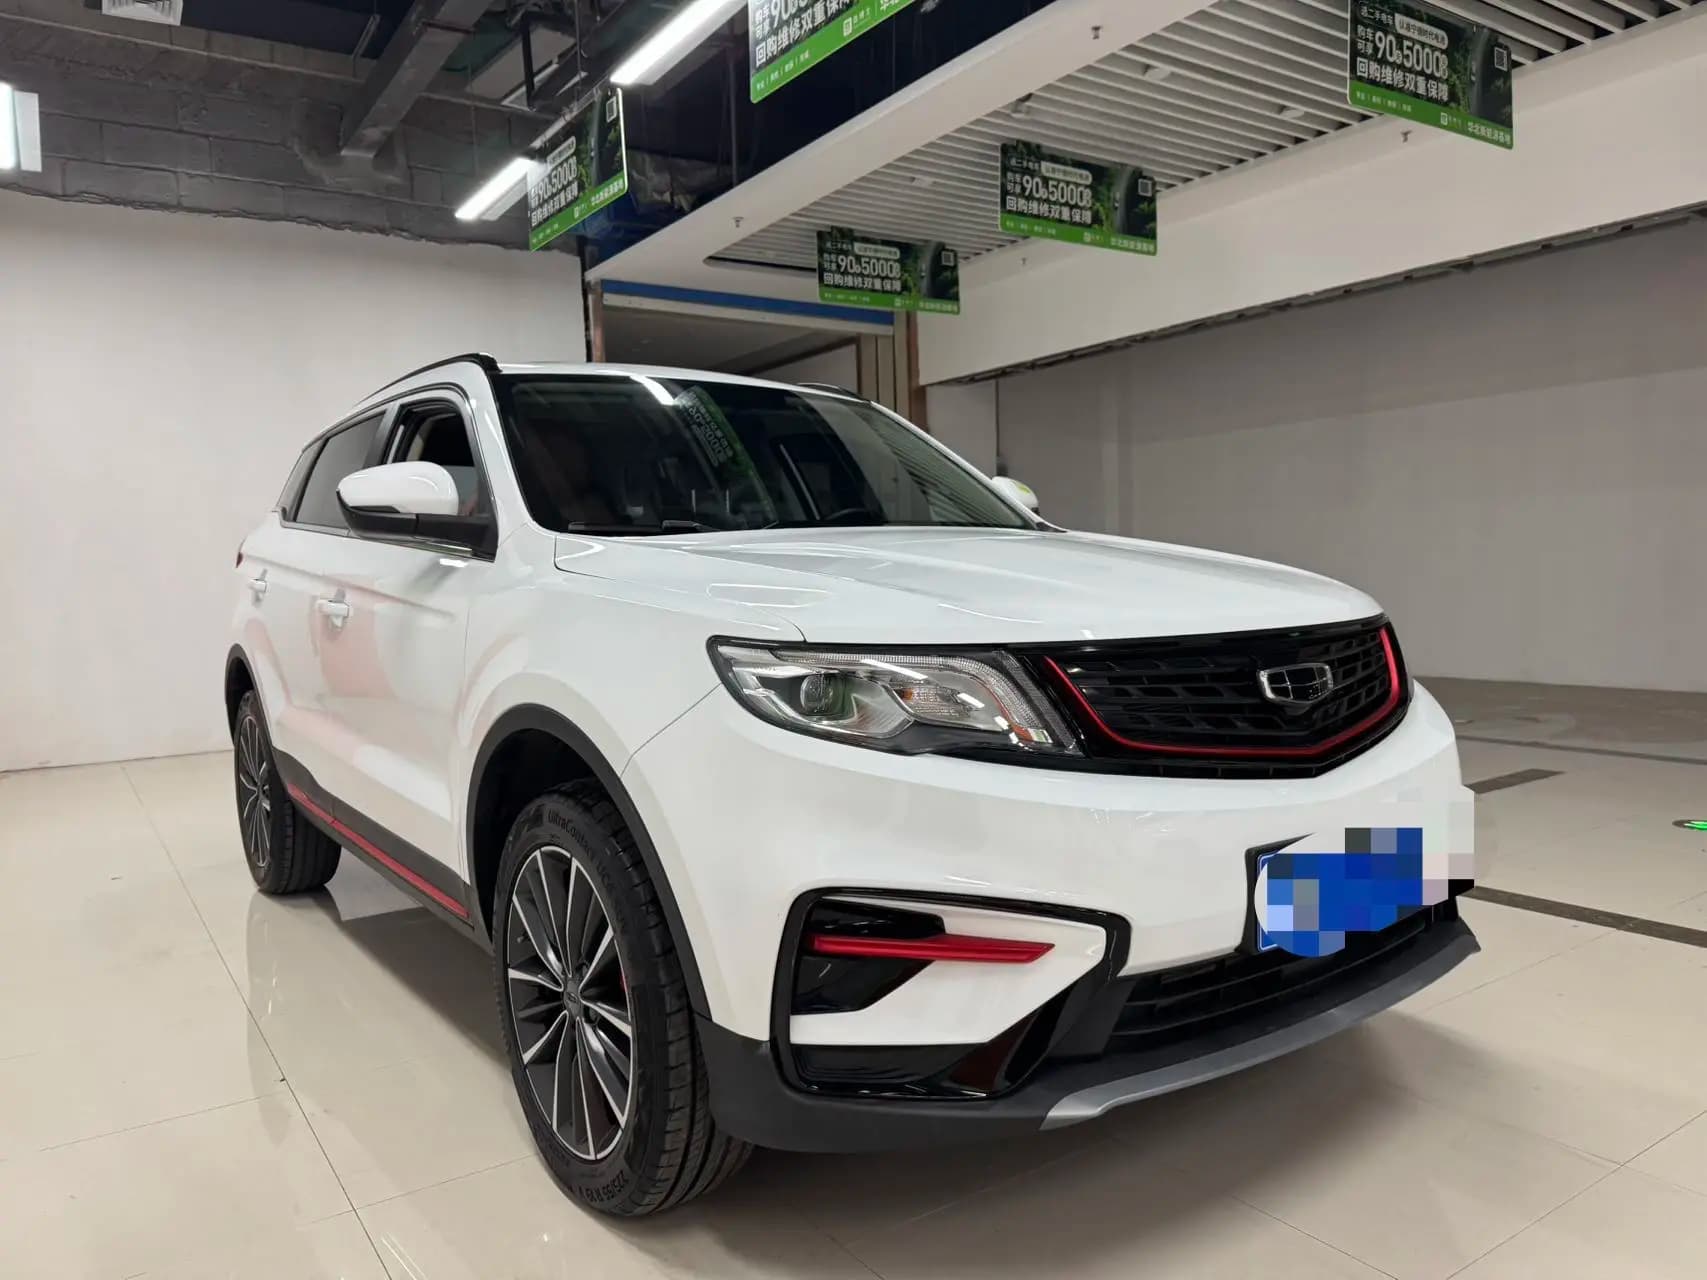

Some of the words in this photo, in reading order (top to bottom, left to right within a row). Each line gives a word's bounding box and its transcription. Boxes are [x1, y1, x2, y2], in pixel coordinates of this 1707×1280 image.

[1356, 57, 1449, 102] 回购维修双重保障
[1006, 196, 1092, 225] 回购维修双重保障
